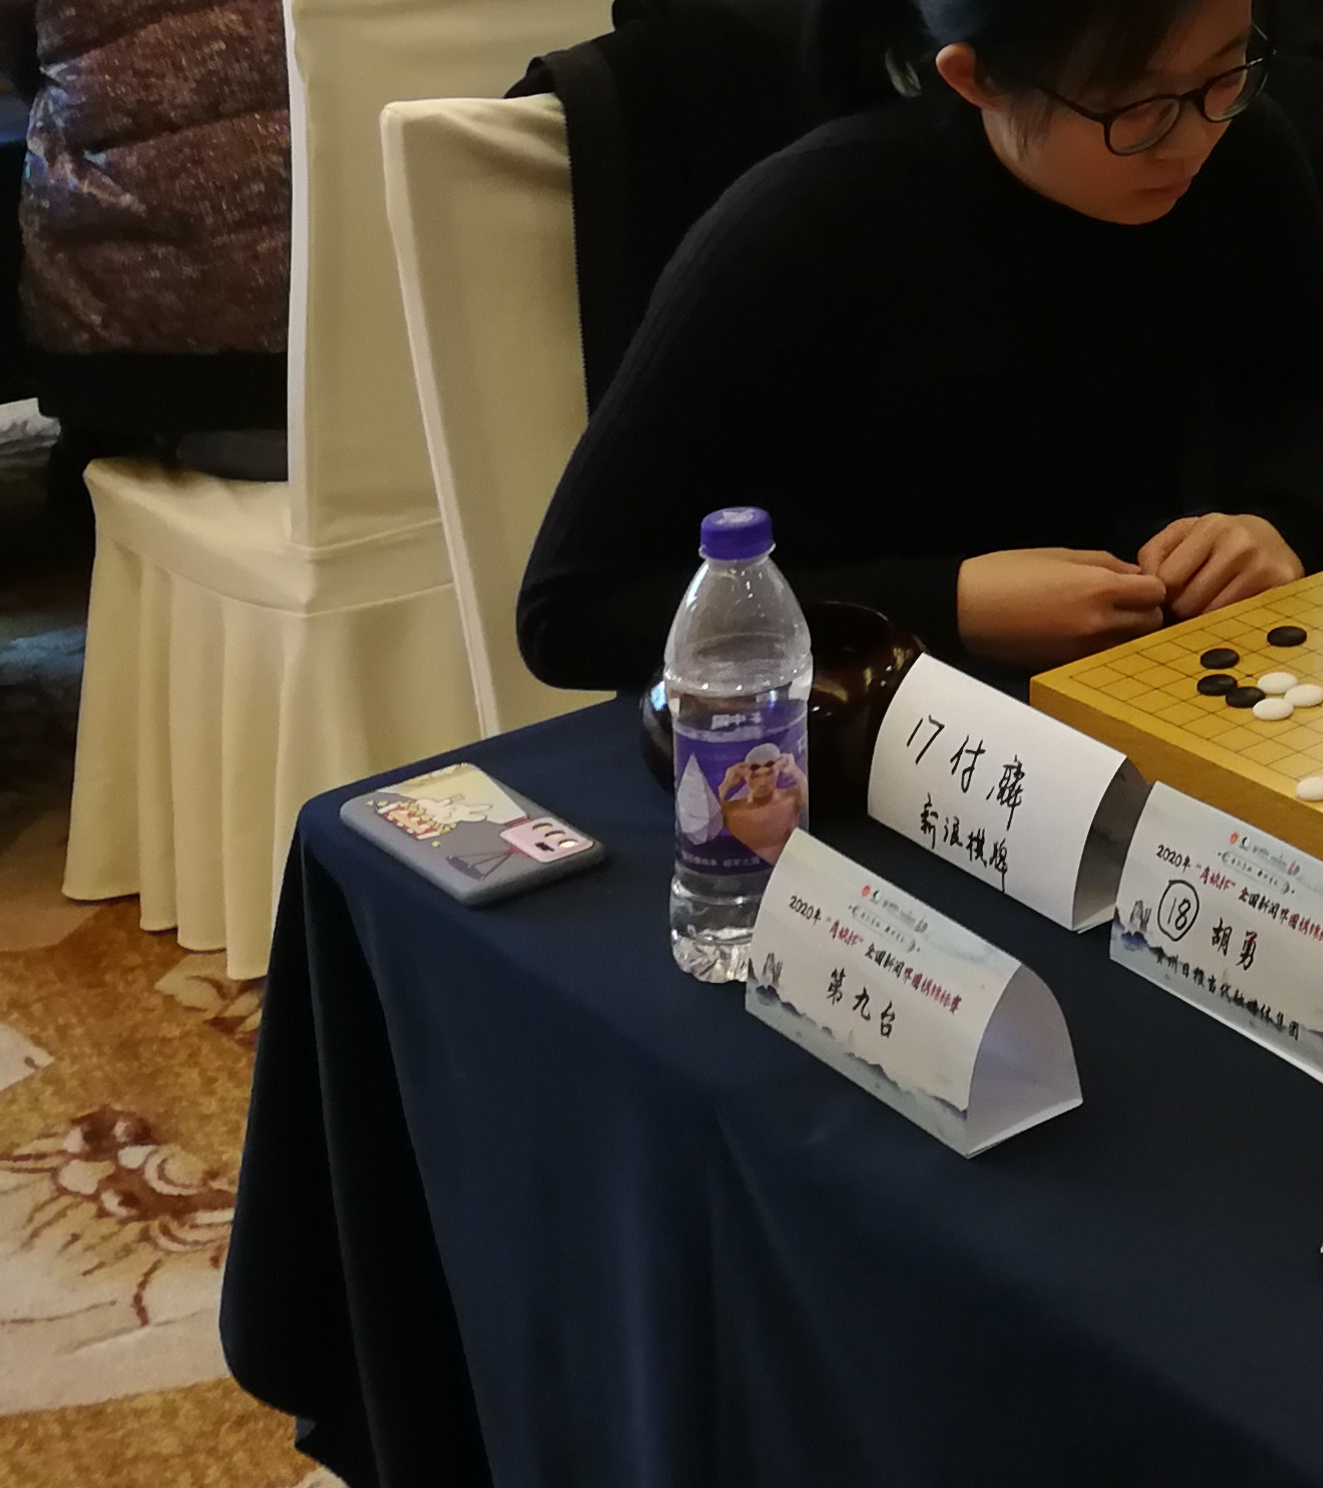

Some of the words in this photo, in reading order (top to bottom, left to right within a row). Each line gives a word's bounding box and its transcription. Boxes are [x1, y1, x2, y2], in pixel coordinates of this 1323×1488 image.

[906, 714, 946, 765] 17
[1167, 898, 1192, 931] 18
[1210, 917, 1260, 972] 胡勇
[826, 967, 897, 1039] 第九台
